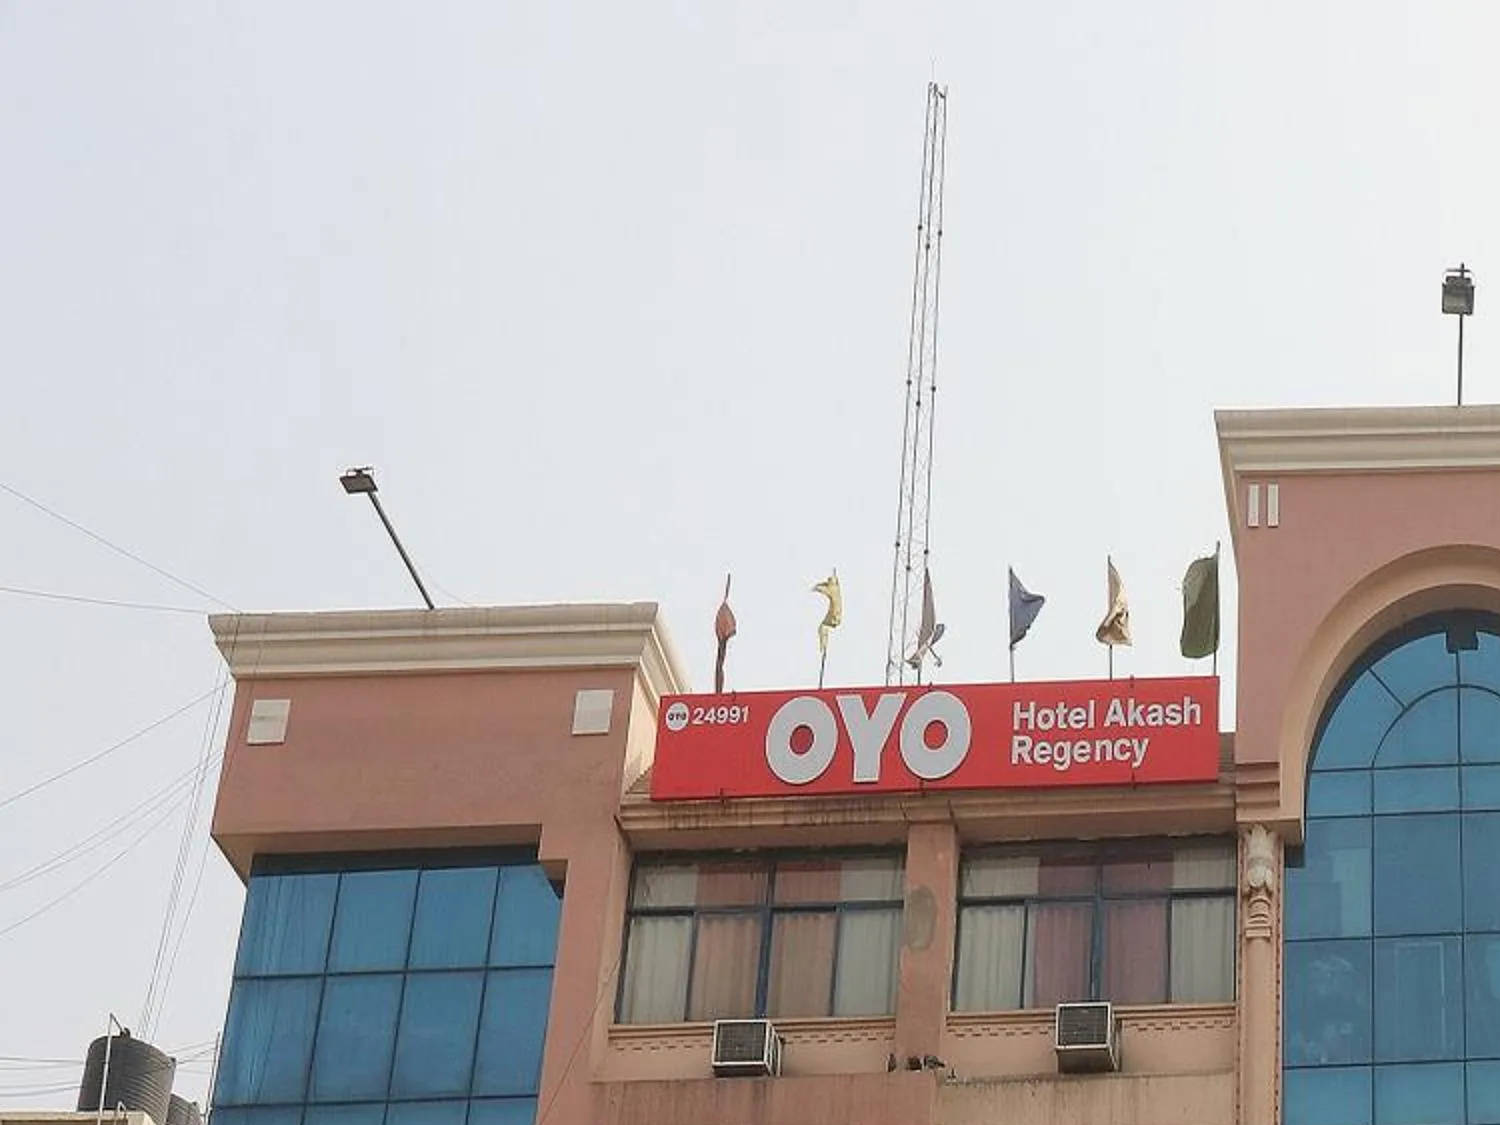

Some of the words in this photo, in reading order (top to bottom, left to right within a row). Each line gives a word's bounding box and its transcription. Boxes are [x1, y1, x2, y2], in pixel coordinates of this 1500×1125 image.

[692, 705, 749, 725] 24991
[1013, 700, 1096, 732] Hotel
[1103, 696, 1201, 728] Akash
[765, 691, 972, 785] OYO
[1011, 735, 1150, 771] Regency
